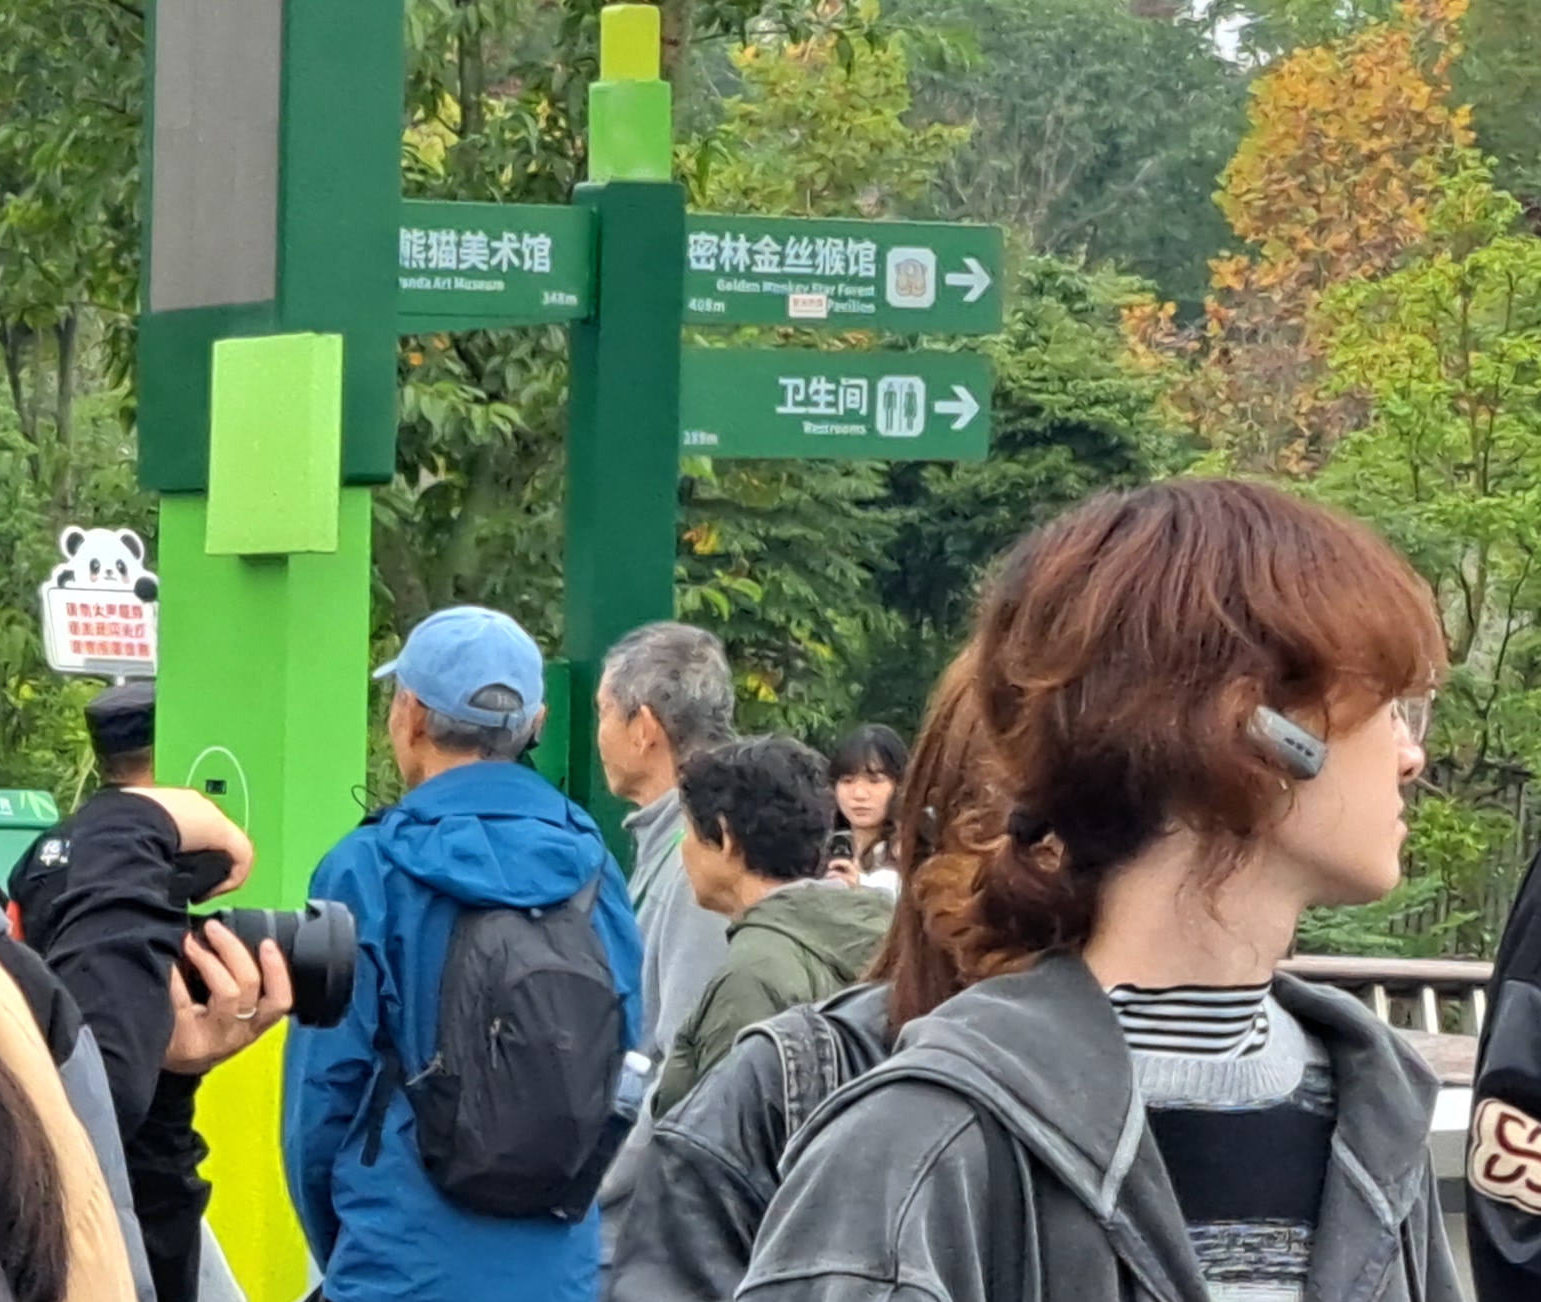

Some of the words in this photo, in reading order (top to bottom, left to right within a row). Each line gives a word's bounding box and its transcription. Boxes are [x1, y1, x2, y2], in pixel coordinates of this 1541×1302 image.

[399, 227, 552, 273] 熊猫美术馆
[688, 231, 877, 278] 密林金丝猴馆
[433, 277, 452, 290] Art
[454, 277, 505, 292] Museum
[716, 279, 760, 293] Golden
[762, 280, 808, 296] Monkey
[837, 283, 875, 297] Forest
[827, 298, 876, 313] Pavilion
[775, 375, 869, 416] 卫生间
[802, 421, 868, 436] Restrooms
